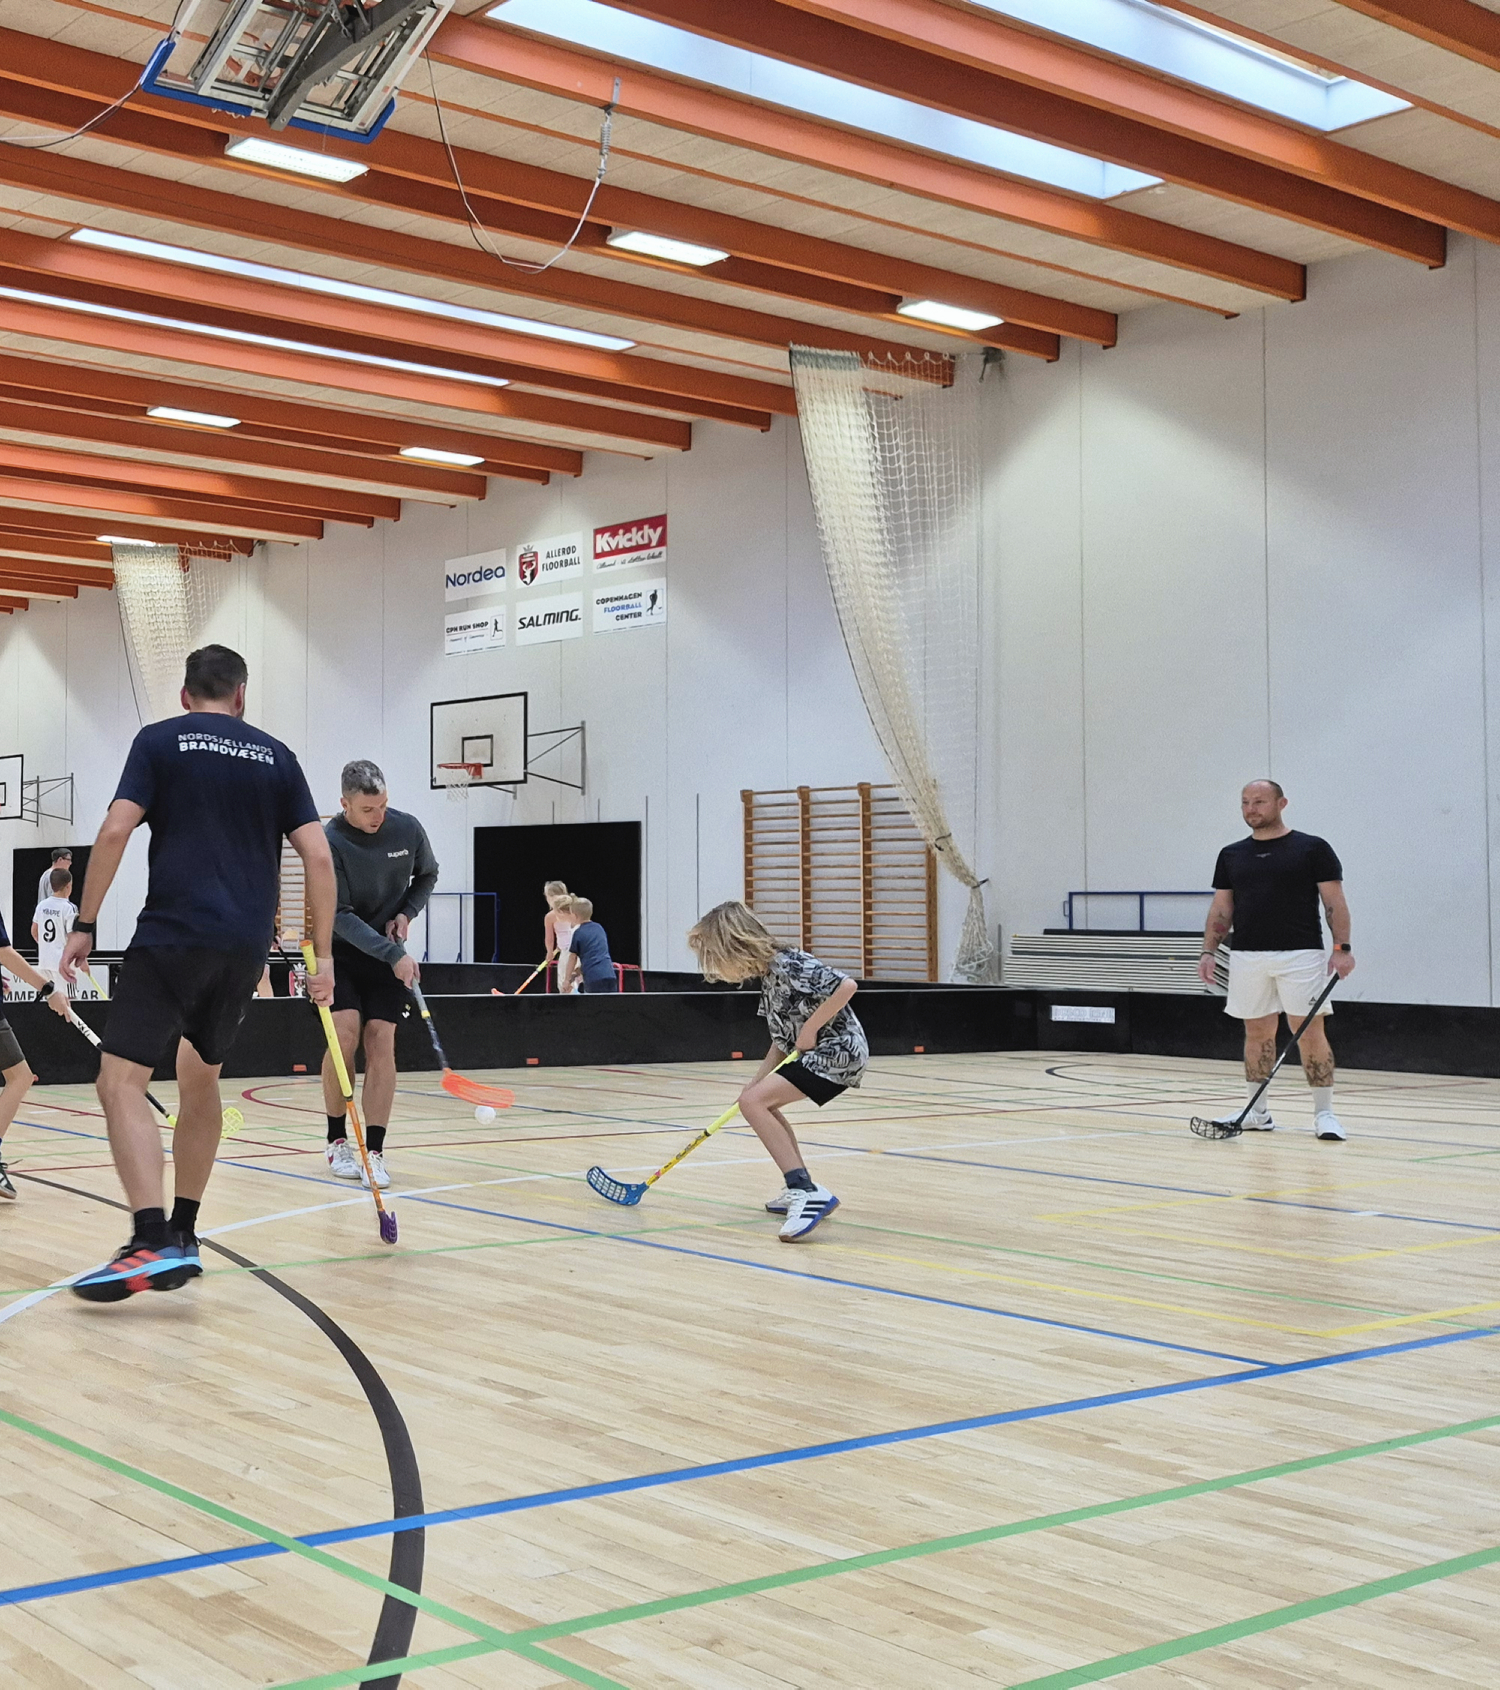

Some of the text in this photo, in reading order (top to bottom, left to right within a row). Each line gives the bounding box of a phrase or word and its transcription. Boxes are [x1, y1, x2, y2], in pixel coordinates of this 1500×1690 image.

[595, 524, 664, 554] Kvickly
[545, 545, 577, 560] ALLERØD
[541, 556, 581, 572] FLOORBALL
[445, 565, 506, 589] Nordea
[595, 592, 643, 605] COPENHAGEN
[603, 602, 642, 613] FLOORBALL
[615, 611, 642, 621] CENTER
[177, 732, 274, 756] NORDSJÆLLANDS
[178, 741, 275, 765] BRANDVÆSEN
[43, 918, 56, 943] 9
